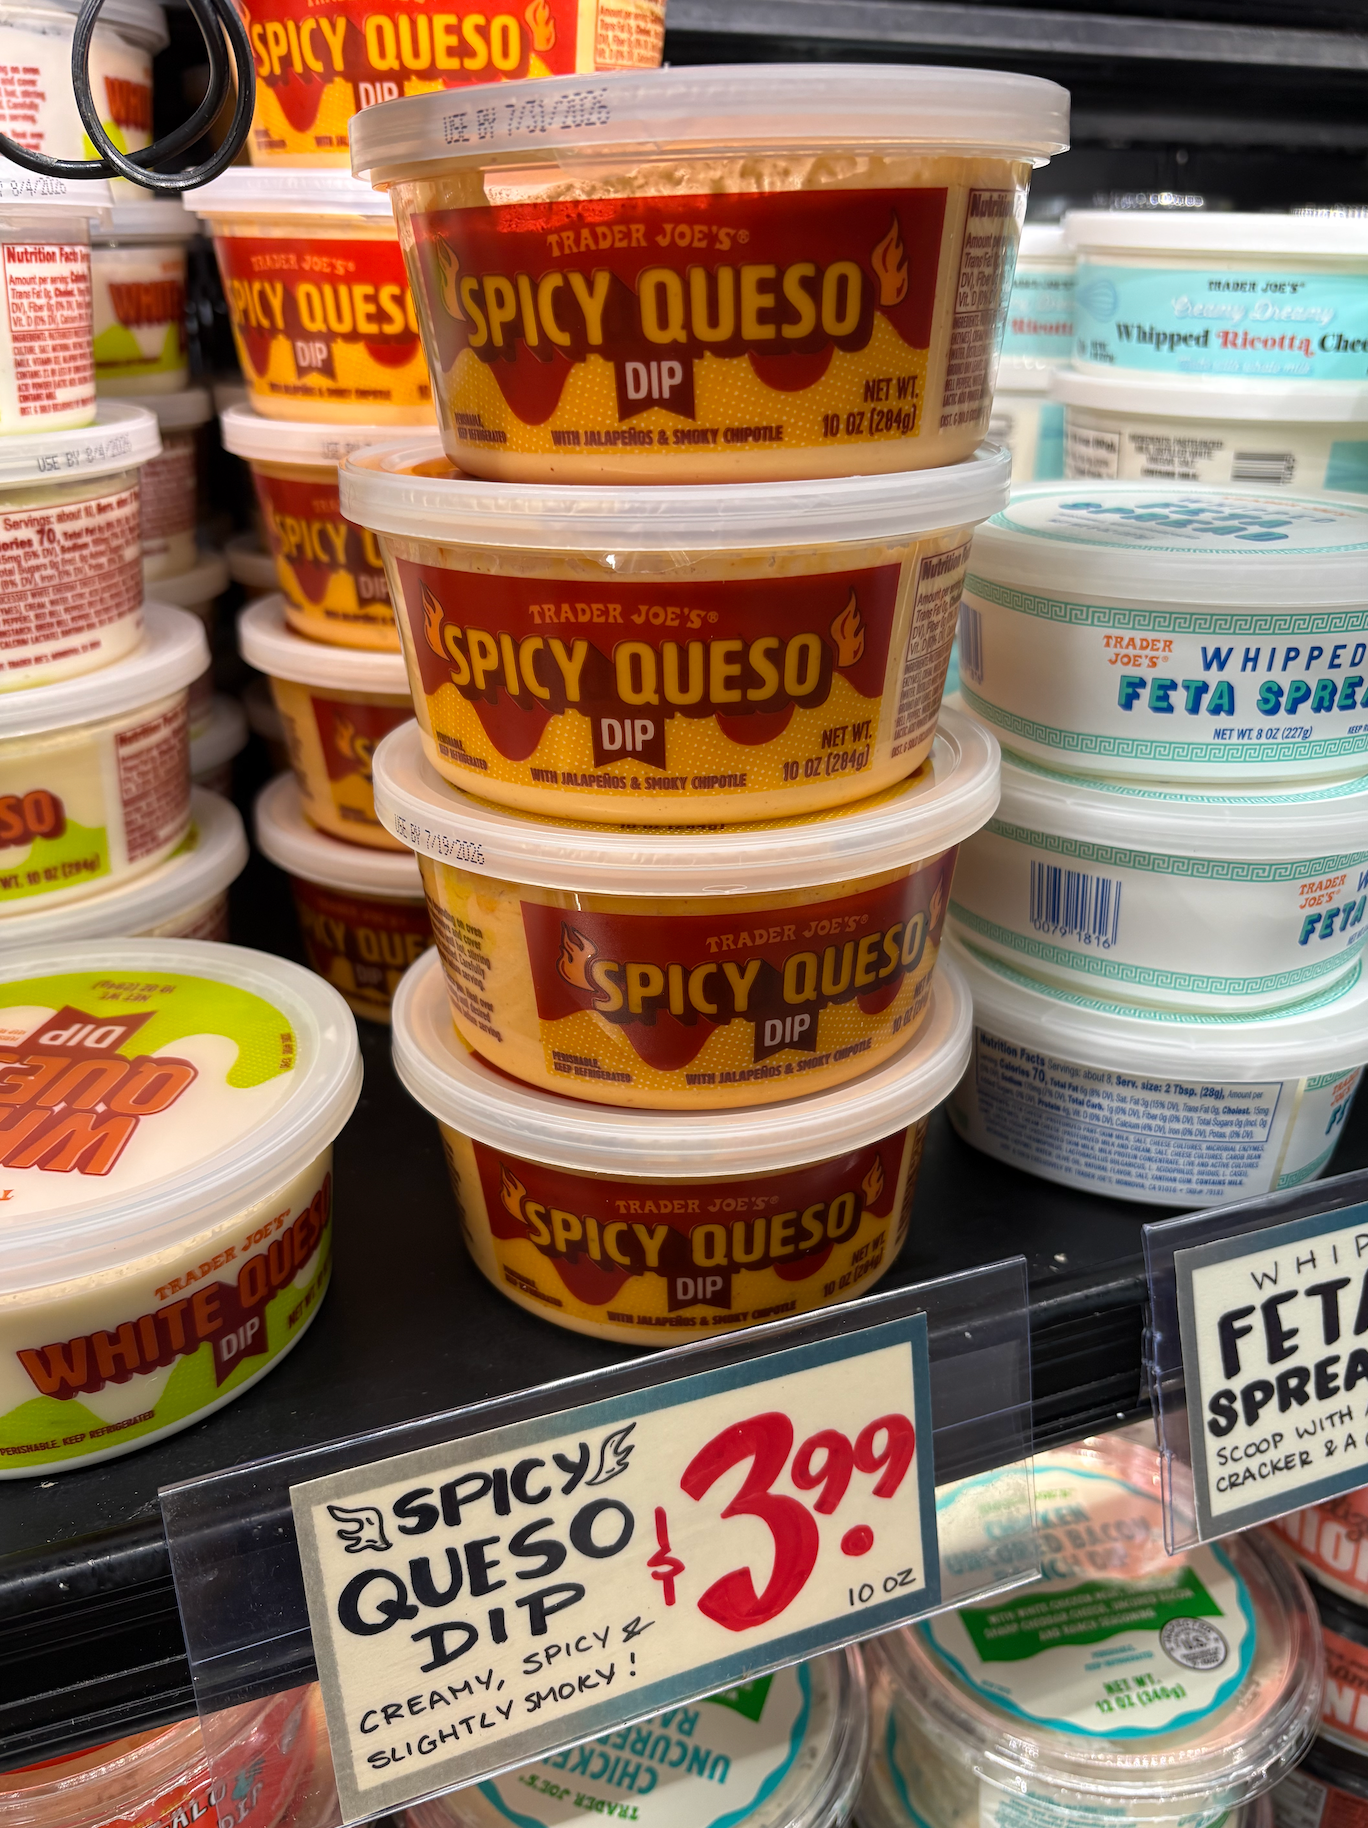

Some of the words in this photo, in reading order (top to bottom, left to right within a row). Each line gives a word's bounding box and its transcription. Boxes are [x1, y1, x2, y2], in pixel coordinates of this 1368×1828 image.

[252, 15, 347, 77] SPICY
[366, 14, 521, 71] QUESO
[6, 246, 57, 264] Nutrition
[547, 224, 647, 257] TRADER
[460, 270, 610, 347] SPICY
[639, 261, 863, 344] QUESO
[295, 341, 328, 368] DIP
[1115, 321, 1209, 352] Whipped
[1215, 328, 1315, 358] Ricotta
[624, 360, 683, 400] DIP
[863, 378, 892, 403] NET
[897, 375, 919, 400] WT.
[551, 429, 580, 446] WITH
[584, 427, 653, 446] JALAPEÑOS
[657, 432, 669, 446] &
[673, 428, 718, 445] SMOKY
[723, 425, 783, 443] CHIPOTLE
[822, 413, 841, 438] 10
[846, 412, 864, 435] OZ
[868, 404, 917, 437] (284g)
[37, 456, 60, 473] USE
[66, 451, 80, 467] BY
[529, 603, 624, 624] TRADER
[1103, 635, 1173, 653] TRADER
[1201, 643, 1368, 672] WHIPPED
[444, 623, 588, 702] SPICY
[615, 633, 822, 705] QUESO
[1118, 675, 1235, 716] FETA
[1257, 676, 1368, 716] SPRE
[600, 718, 655, 751] DIP
[821, 726, 848, 750] NET
[851, 720, 872, 743] WT.
[1213, 728, 1234, 740] NET
[1236, 728, 1253, 740] WT.
[1256, 728, 1263, 740] 8
[1265, 728, 1280, 740] OZ
[1282, 726, 1313, 740] (227g)
[530, 768, 558, 784] WITH
[561, 771, 626, 790] JALAPEÑOS
[630, 776, 641, 790] &
[644, 776, 688, 790] SMOKY
[691, 773, 747, 790] CHIPOTLE
[783, 761, 800, 782] 10
[804, 757, 821, 777] OZ
[825, 744, 870, 777] (284g)
[26, 870, 41, 885] 10
[1298, 873, 1347, 896] TRADER
[1298, 894, 1367, 947] FETA
[706, 924, 796, 953] TRADER
[592, 959, 762, 1015] SPICY
[783, 911, 925, 1004] QUESO
[39, 1023, 128, 1048] DIP
[764, 1013, 811, 1047] DIP
[685, 1072, 715, 1086] WITH
[718, 1064, 781, 1084] JALAPEÑOS
[784, 1062, 795, 1075] &
[796, 1051, 832, 1072] SMOKY
[833, 1037, 872, 1063] CHIPOTLE
[980, 1032, 1017, 1057] Nutrition
[1019, 1048, 1045, 1066] Facts
[1047, 1058, 1081, 1078] Servings:
[1083, 1068, 1105, 1084] about
[1115, 1075, 1138, 1089] Serv.
[1140, 1080, 1162, 1093] size:
[1164, 1083, 1171, 1094] 2
[1173, 1083, 1197, 1099] Tbsp.
[1227, 1089, 1252, 1099] Amount
[0, 1055, 197, 1116] QUE
[999, 1057, 1030, 1078] Calories
[1032, 1067, 1048, 1086] 70,
[1049, 1077, 1067, 1089] Total
[1067, 1081, 1079, 1093] Fat
[1182, 1103, 1199, 1113] Trans
[1068, 1094, 1085, 1105] Total
[615, 1200, 700, 1213] TRADER
[525, 1200, 668, 1267] SPICY
[692, 1192, 855, 1267] QUESO
[852, 1243, 870, 1267] NET
[1250, 1233, 1368, 1290] WHIP
[155, 1245, 238, 1301] TRADER
[676, 1275, 723, 1300] DIP
[824, 1281, 835, 1297] 10
[839, 1274, 851, 1290] OZ
[607, 1311, 633, 1325] WITH
[636, 1314, 697, 1327] JALAPEÑOS
[712, 1311, 748, 1325] SMOKY
[17, 1283, 223, 1393] WHITE
[220, 1316, 260, 1362] DIP
[1207, 1348, 1368, 1437] SPREA
[62, 1433, 86, 1446] KEEP
[89, 1409, 155, 1439] REFRIGERATED
[1216, 1432, 1284, 1467] SCOOP
[1295, 1404, 1354, 1440] WITH
[1215, 1449, 1313, 1493] CRACKER
[1324, 1440, 1338, 1457] &
[1344, 1433, 1357, 1450] A
[393, 1442, 590, 1537] SPICY
[337, 1497, 635, 1635] QUESO
[848, 1582, 875, 1607] 10
[882, 1568, 917, 1593] OZ
[411, 1581, 586, 1673] DIP
[359, 1669, 507, 1735] CREAMY,
[522, 1631, 611, 1675] SPICY
[621, 1616, 655, 1643] &
[1103, 1676, 1130, 1696] NET
[1132, 1672, 1162, 1691] WT.
[1095, 1697, 1115, 1713] 12
[1117, 1694, 1135, 1710] OZ
[366, 1698, 516, 1771] SLIGHTLY
[576, 1790, 640, 1820] TRADER
